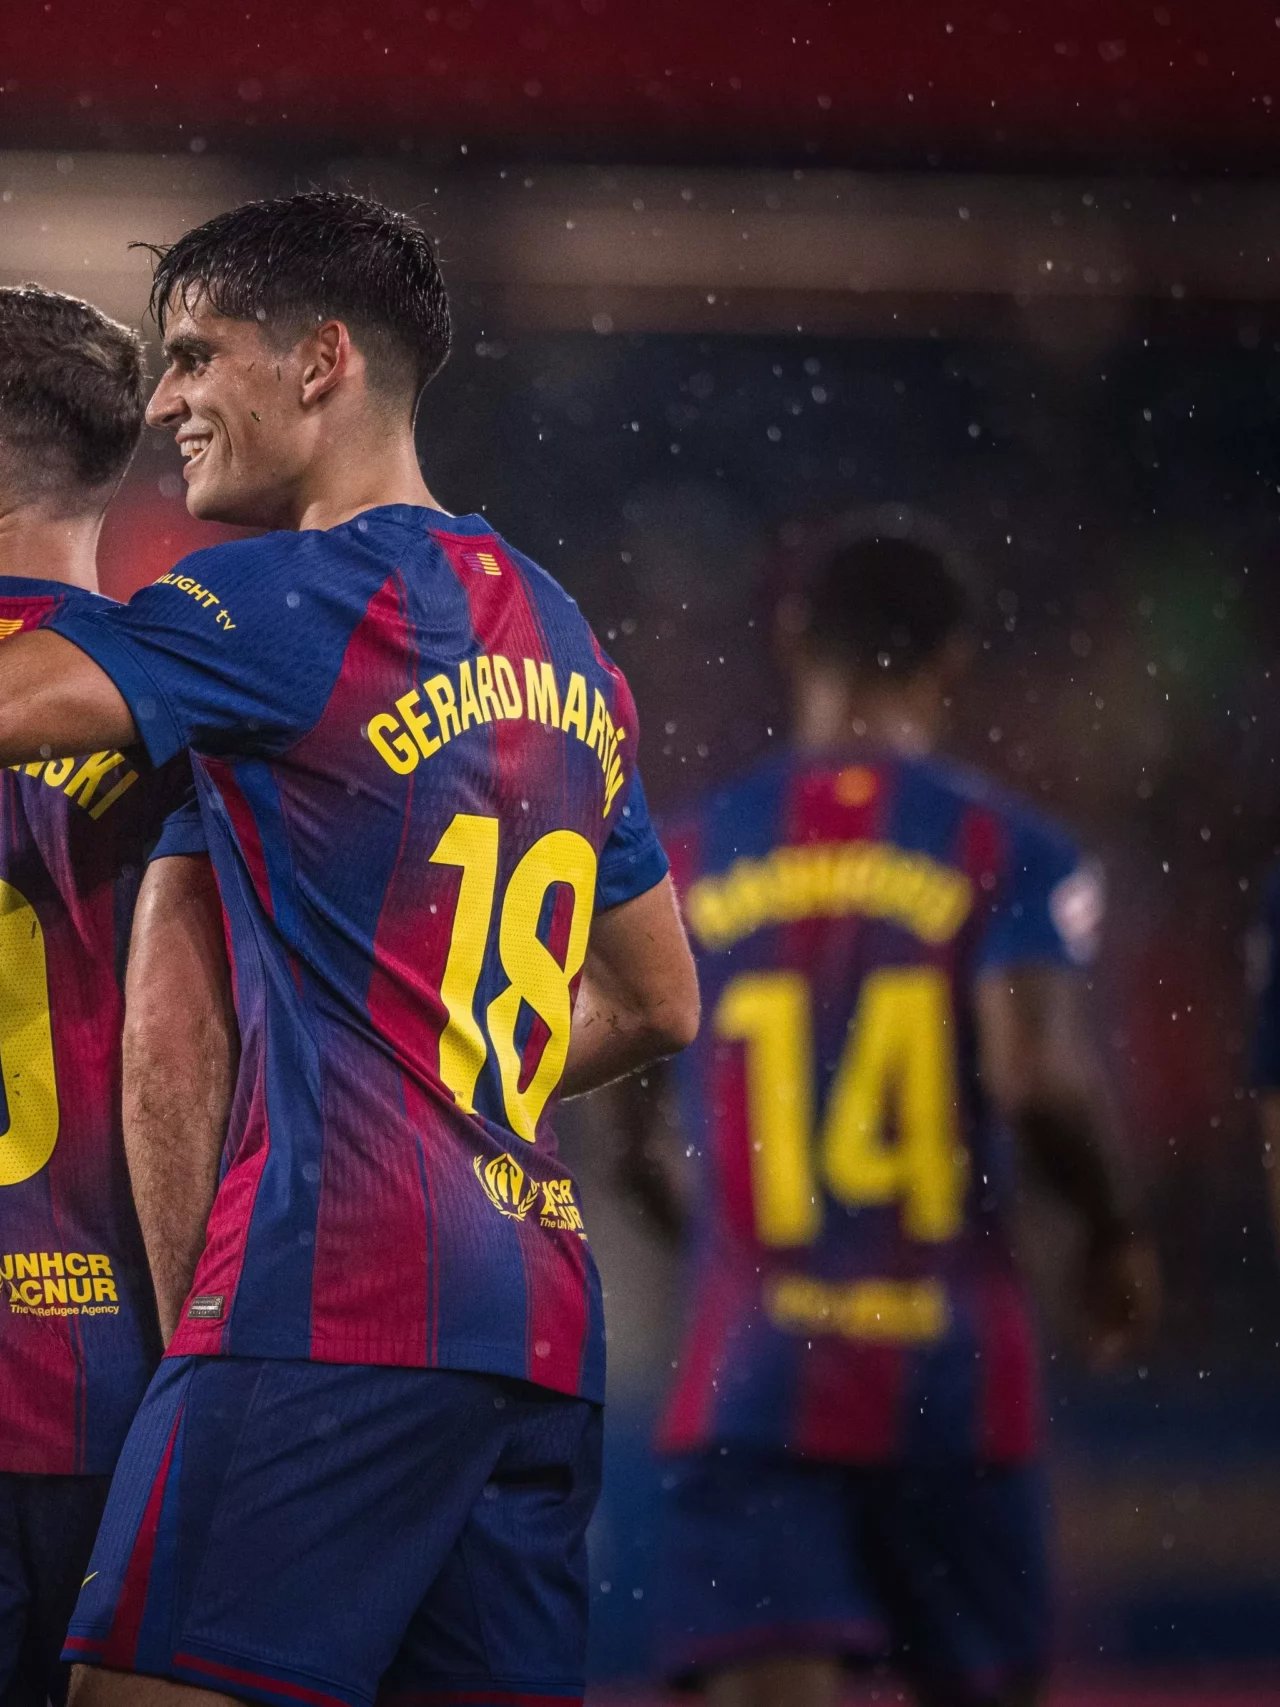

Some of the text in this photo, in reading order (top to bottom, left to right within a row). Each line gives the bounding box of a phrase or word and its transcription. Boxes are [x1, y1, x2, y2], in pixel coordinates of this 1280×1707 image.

[215, 609, 237, 631] tv
[367, 655, 523, 775] GERARD
[428, 813, 598, 1144] 18
[714, 964, 968, 1248] 14
[8, 1277, 119, 1307] ACNUR
[10, 1304, 28, 1314] The
[38, 1306, 80, 1317] Refugee
[81, 1305, 120, 1316] Agency
